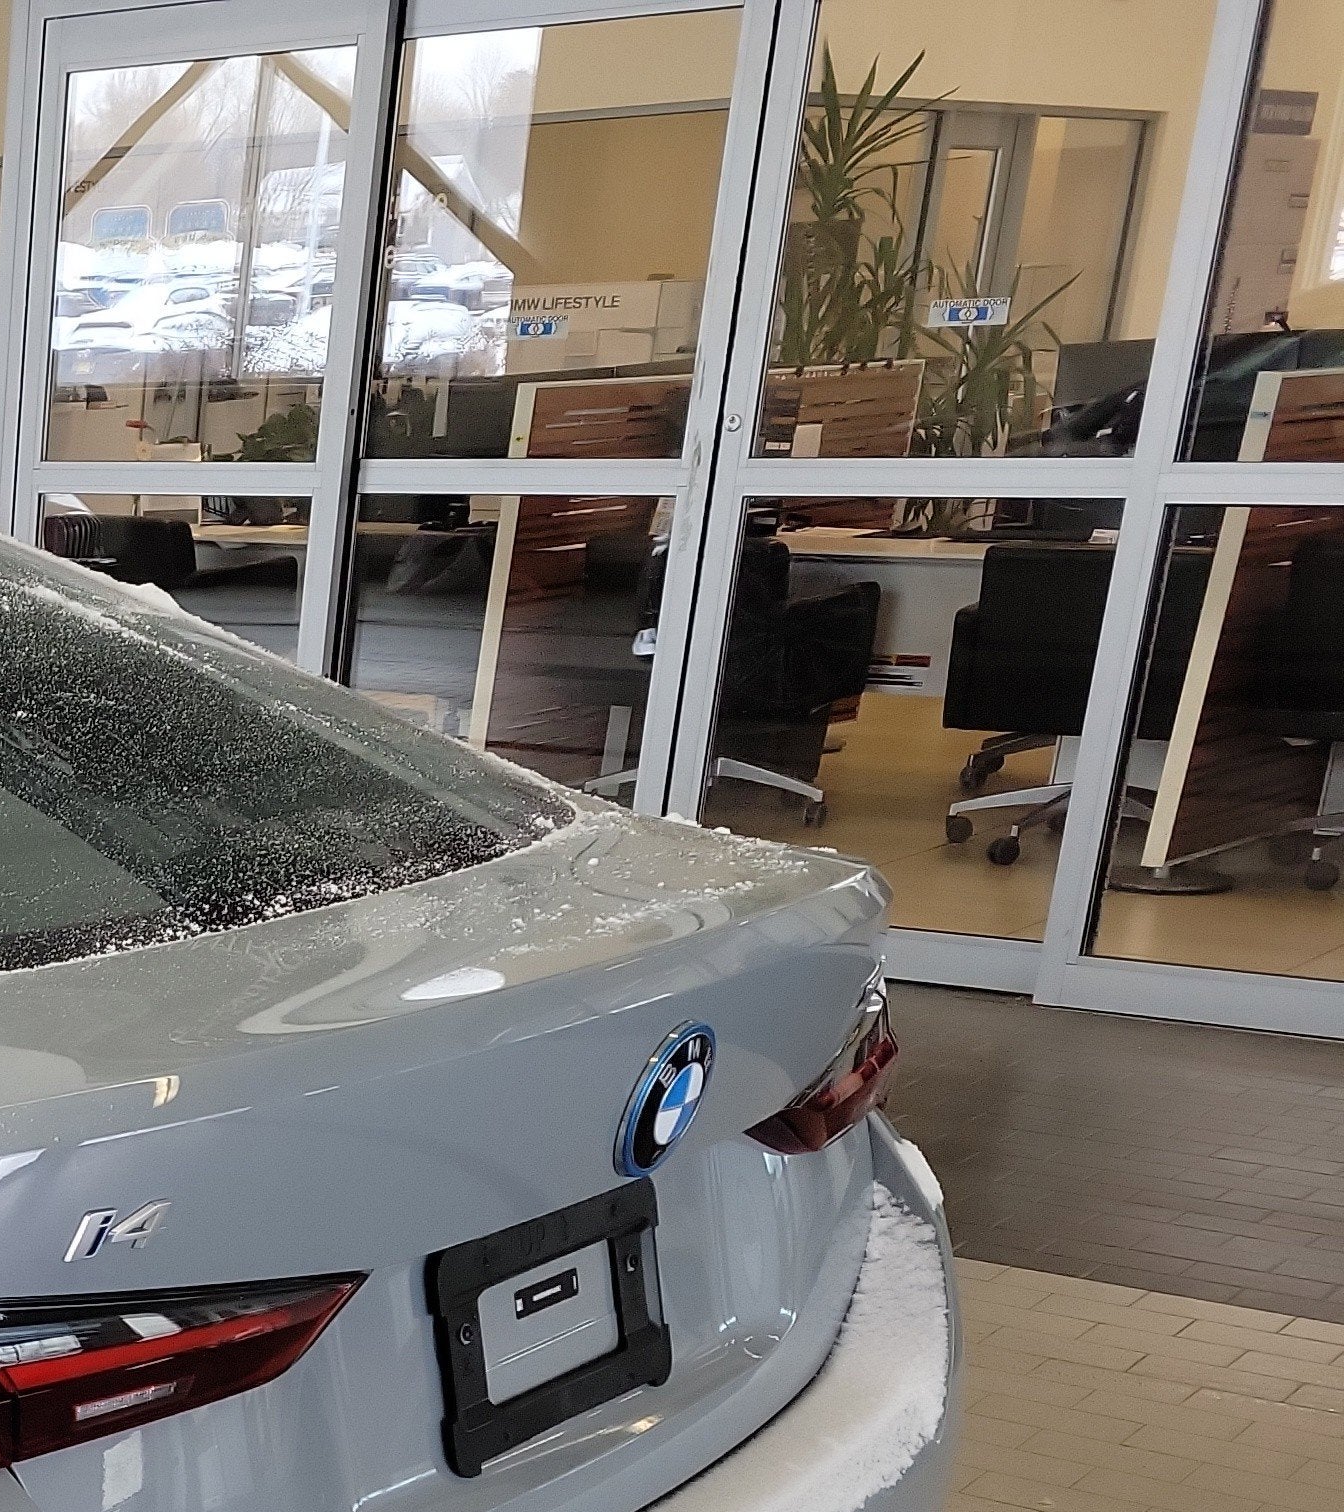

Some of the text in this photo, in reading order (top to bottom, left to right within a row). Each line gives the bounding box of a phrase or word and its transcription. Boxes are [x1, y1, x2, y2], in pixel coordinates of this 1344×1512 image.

[543, 295, 621, 310] LIFESTYLE
[932, 299, 1008, 309] AUTOMATIC DOOR
[62, 1198, 173, 1262] i4
